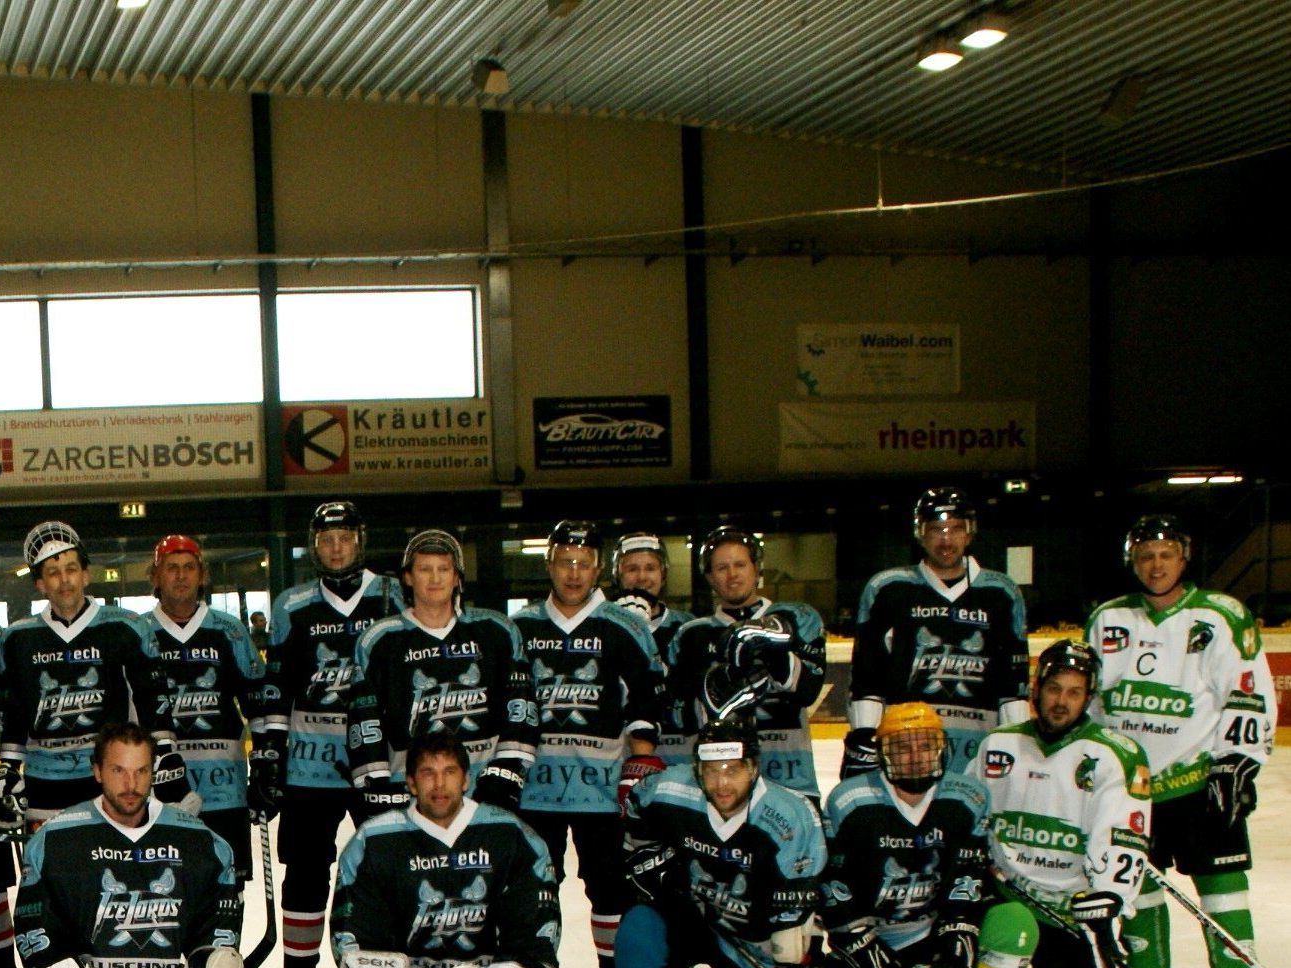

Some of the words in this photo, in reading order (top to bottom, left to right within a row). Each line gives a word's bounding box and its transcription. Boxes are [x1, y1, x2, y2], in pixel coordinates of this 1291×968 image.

[10, 418, 100, 431] Brandschutztüren
[111, 415, 184, 427] Verladetechnik
[193, 412, 253, 427] Stahlzargen
[354, 407, 487, 431] Kräutler
[355, 433, 488, 449] Elektromaschinen
[878, 419, 1027, 456] rheinpark
[23, 436, 254, 472] ZARGENBÖSCH
[354, 455, 488, 470] www.kraeutler.at
[1136, 653, 1157, 677] C
[1122, 719, 1140, 733] Ihr
[1141, 722, 1179, 737] Maler
[1225, 715, 1260, 746] 40
[996, 815, 1078, 849] Palaoro
[1017, 850, 1034, 864] Ihr
[1035, 854, 1073, 872] Maler
